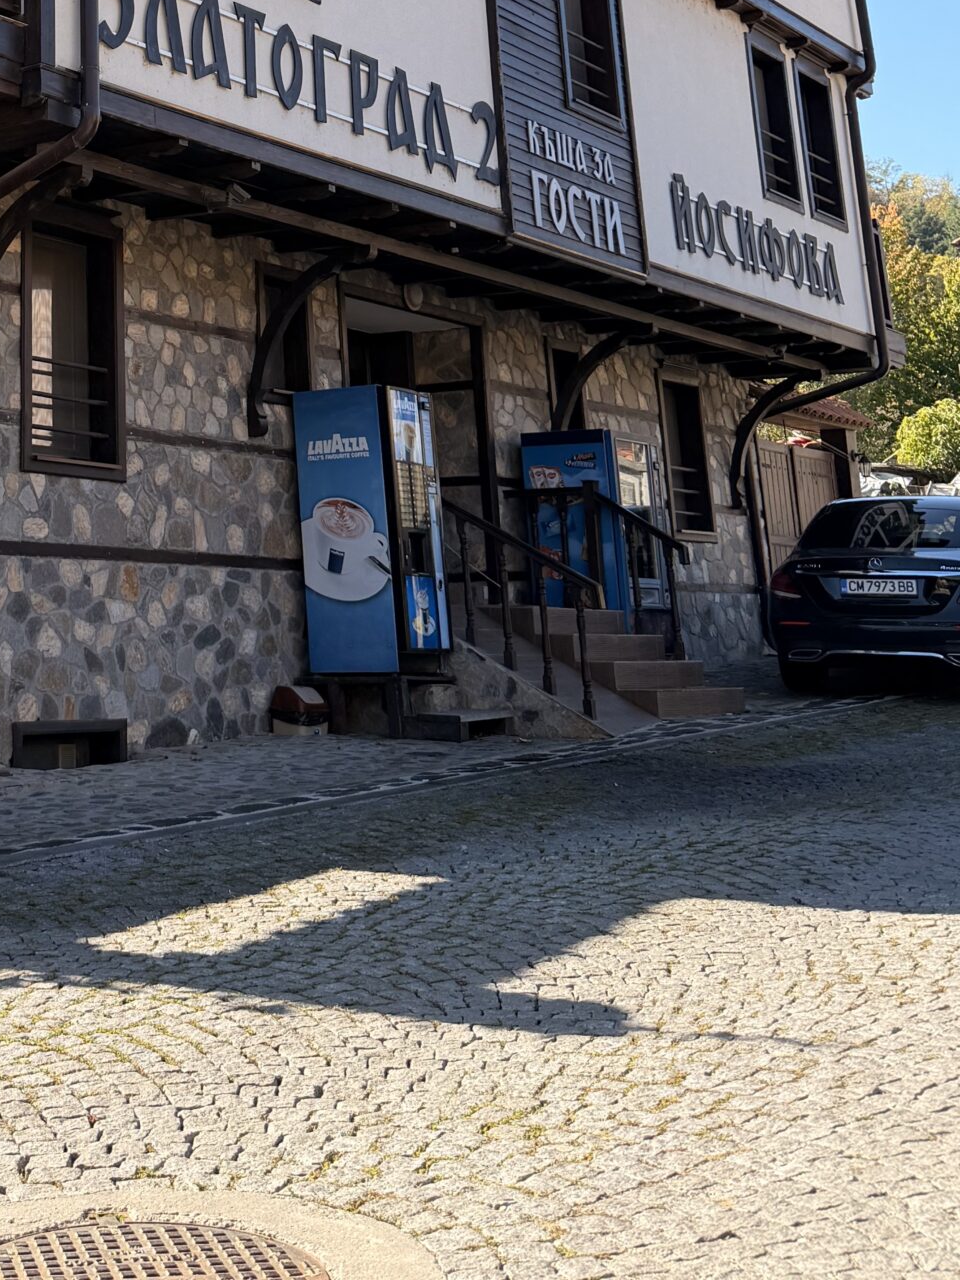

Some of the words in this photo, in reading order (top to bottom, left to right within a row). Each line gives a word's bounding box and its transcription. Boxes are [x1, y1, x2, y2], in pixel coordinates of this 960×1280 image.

[471, 100, 501, 187] 2
[526, 119, 588, 175] КЪЩА
[591, 146, 617, 185] ЗА
[530, 169, 627, 256] ГОСТИ
[670, 172, 845, 305] ЙОСИФОВА
[307, 433, 369, 455] LAVAZZA
[848, 580, 865, 592] CM
[866, 580, 896, 593] 7973
[898, 581, 914, 593] BB
